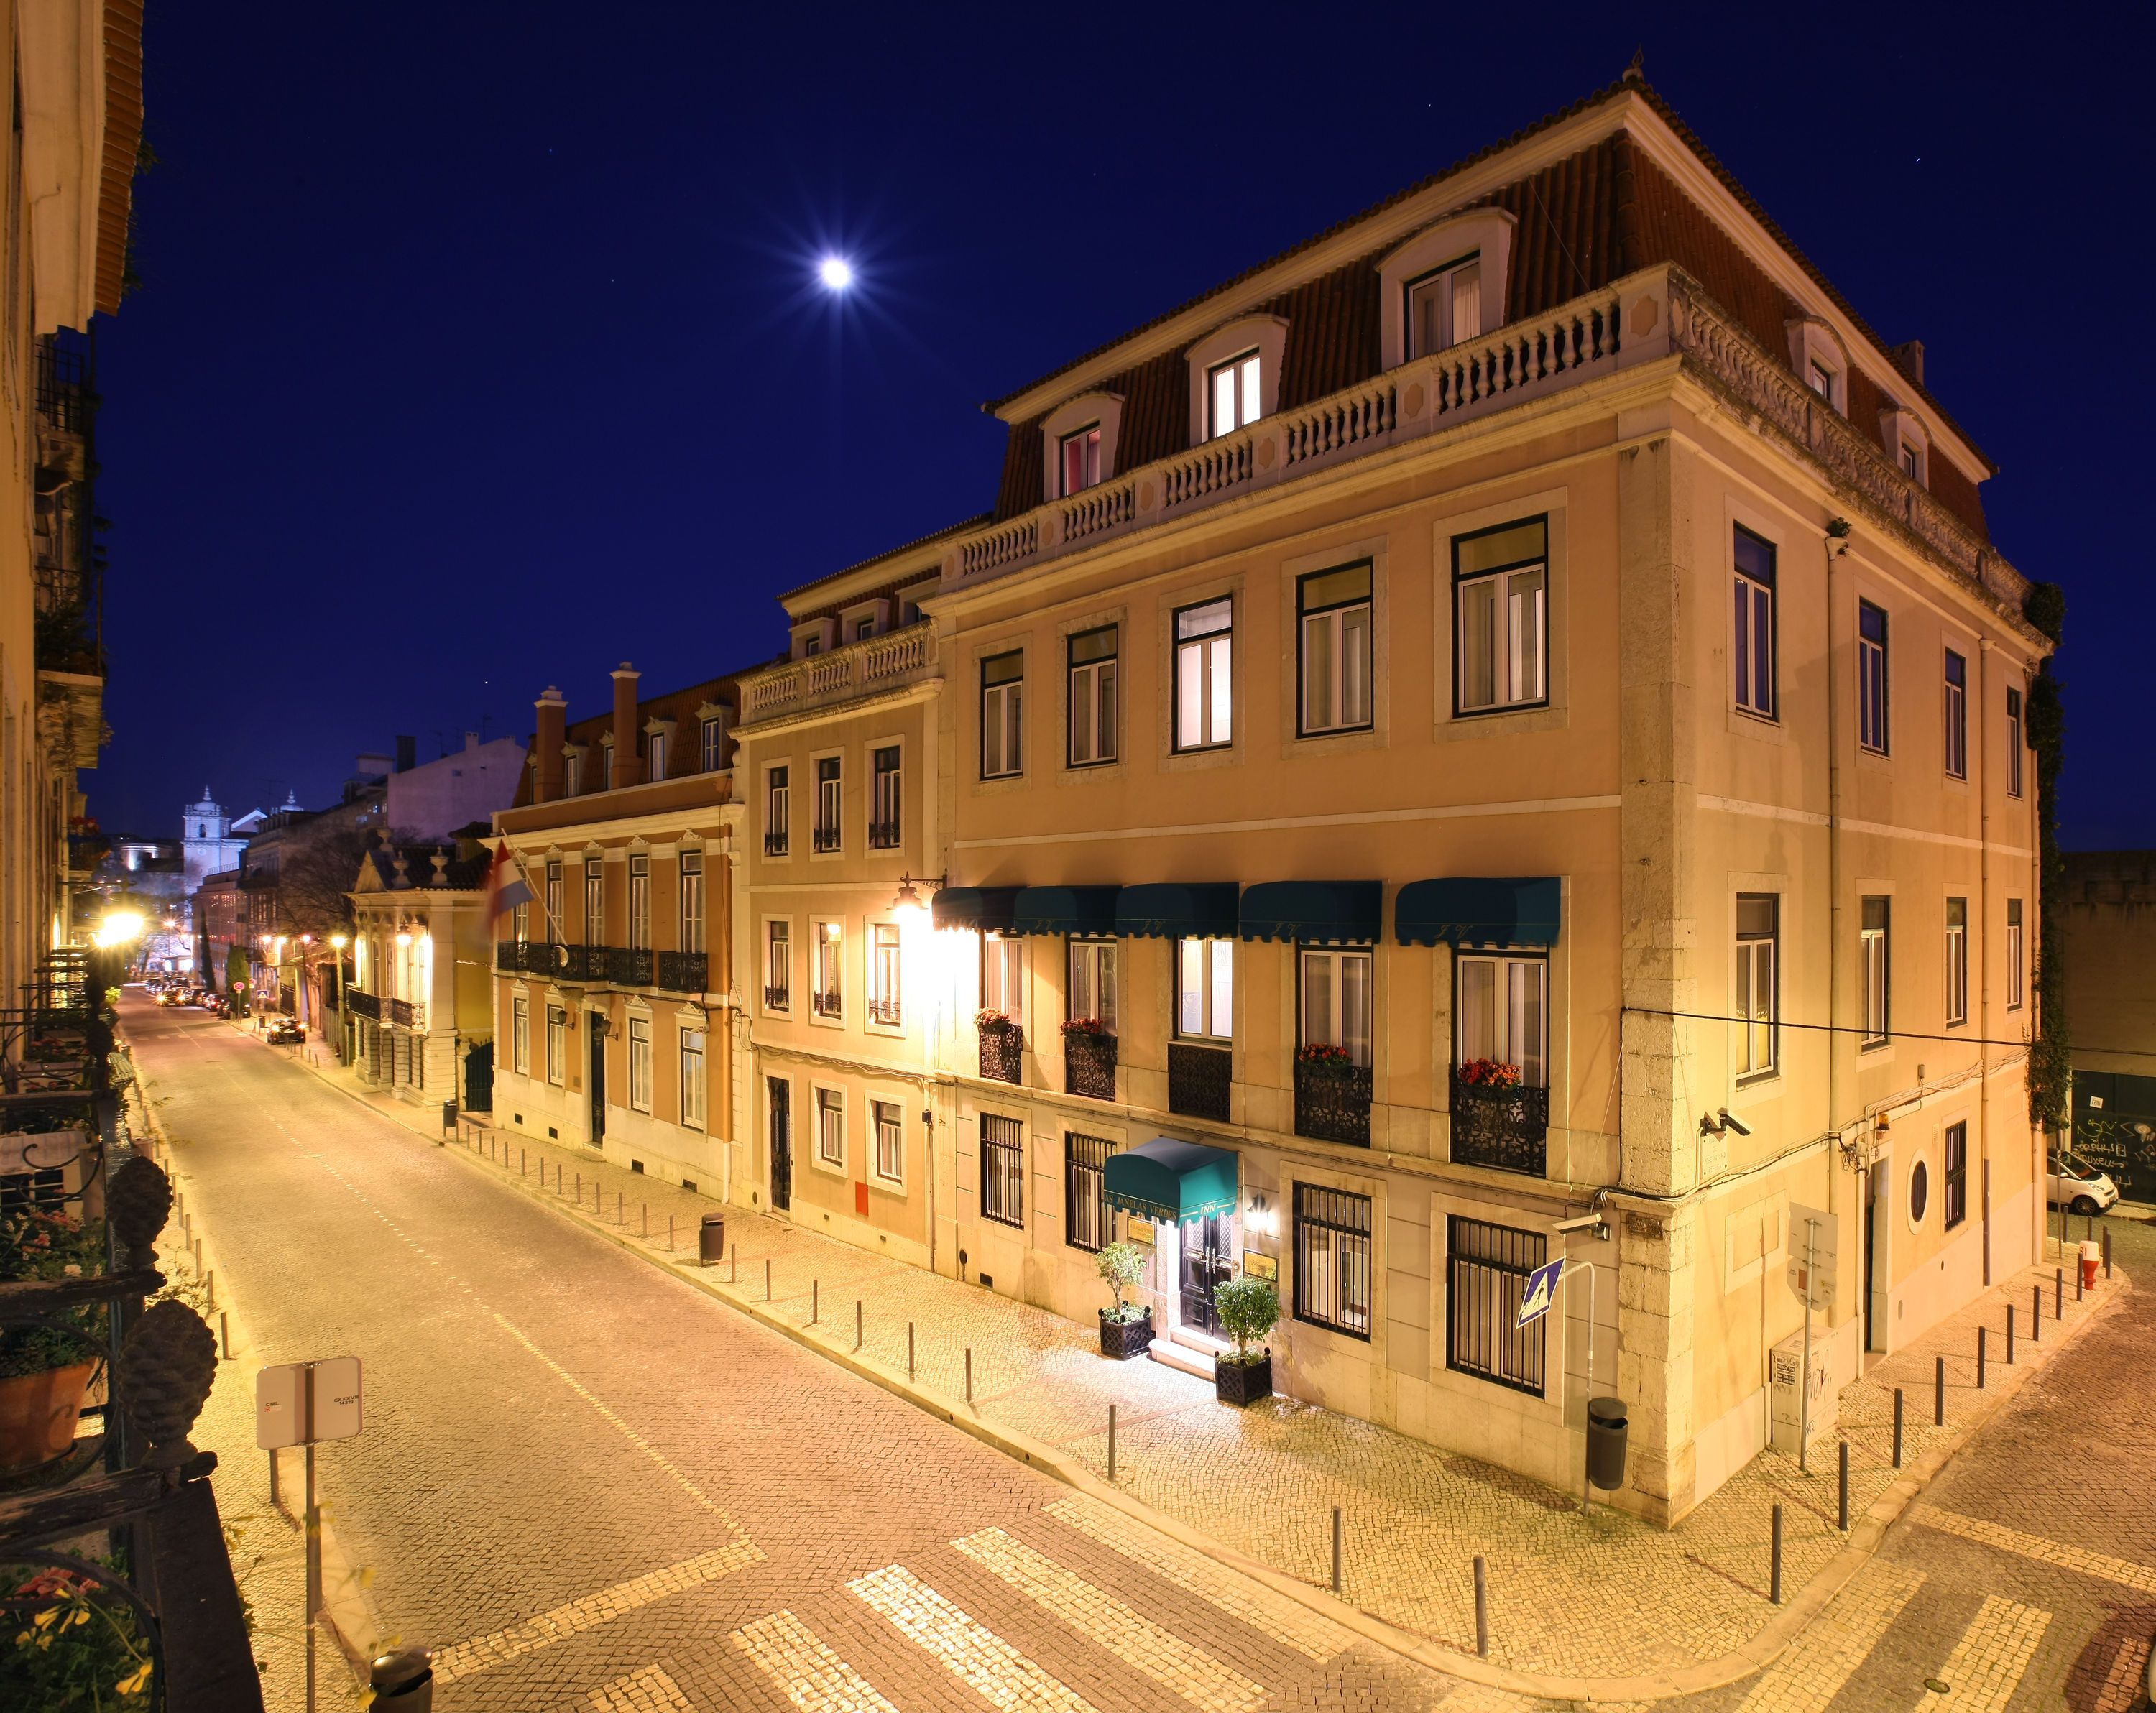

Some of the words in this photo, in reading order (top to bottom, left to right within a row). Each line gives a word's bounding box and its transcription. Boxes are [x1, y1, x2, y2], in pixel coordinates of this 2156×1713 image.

[1105, 1194, 1114, 1204] AS
[1118, 1196, 1147, 1212] JANELAS
[1150, 1205, 1177, 1219] VERDES
[1200, 1204, 1217, 1214] INN
